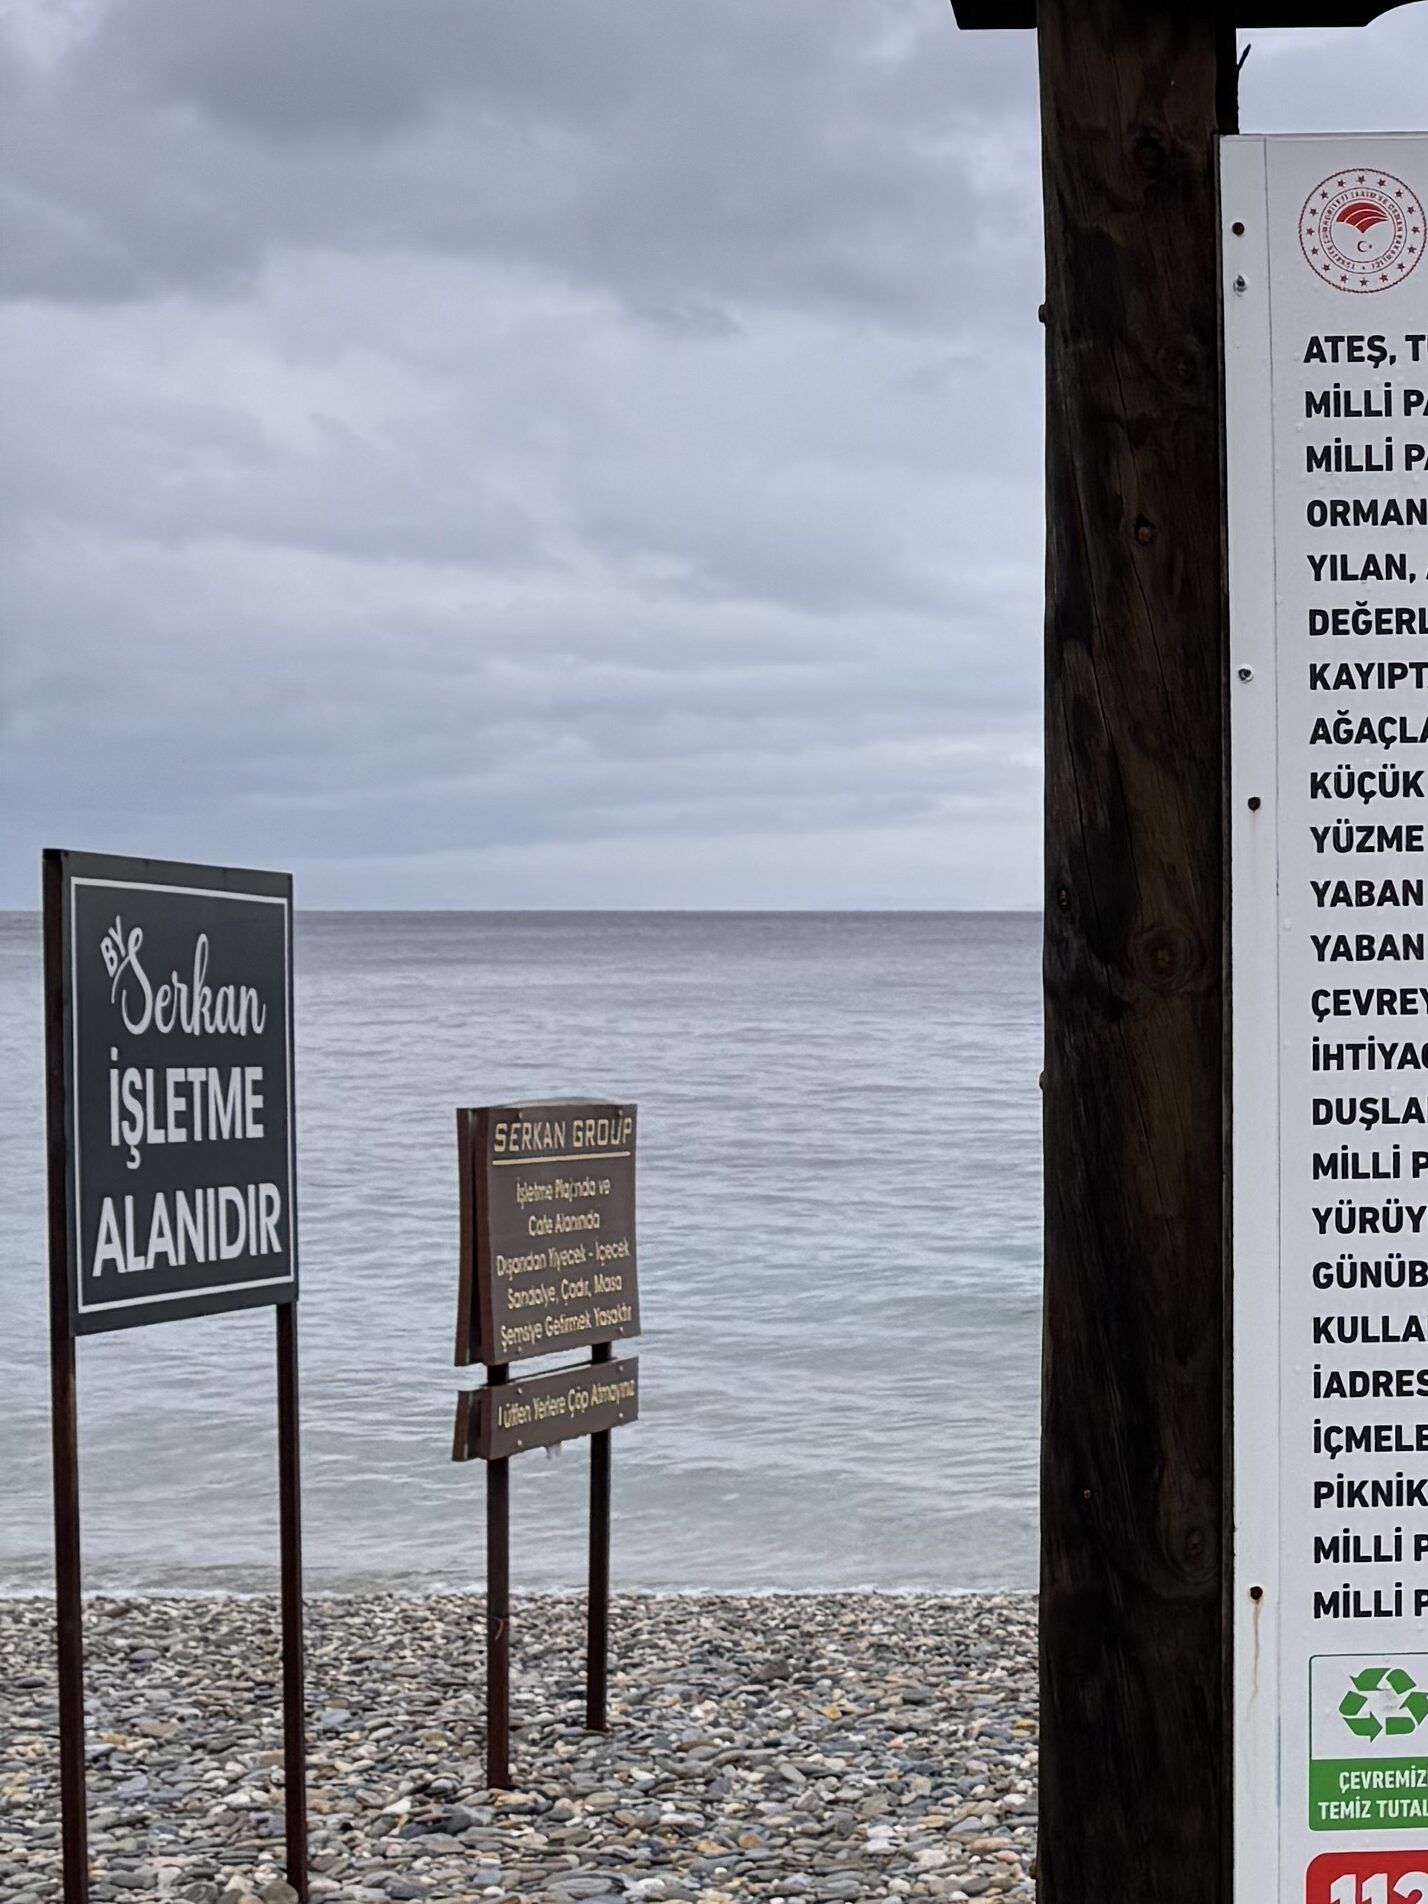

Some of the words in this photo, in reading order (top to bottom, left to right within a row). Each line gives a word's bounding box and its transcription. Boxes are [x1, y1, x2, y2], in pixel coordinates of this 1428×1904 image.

[1303, 335, 1396, 369] ATEŞ,
[1306, 436, 1393, 473] MİLLİ
[100, 915, 126, 978] BY
[111, 927, 266, 1036] Serkan
[110, 1046, 264, 1170] İŞLETME
[494, 1121, 566, 1152] SERKAN
[572, 1117, 632, 1147] GROUP
[92, 1182, 282, 1277] ALANIDIR
[1313, 1581, 1403, 1619] MİLLİ
[1318, 1796, 1371, 1821] TEMİZ
